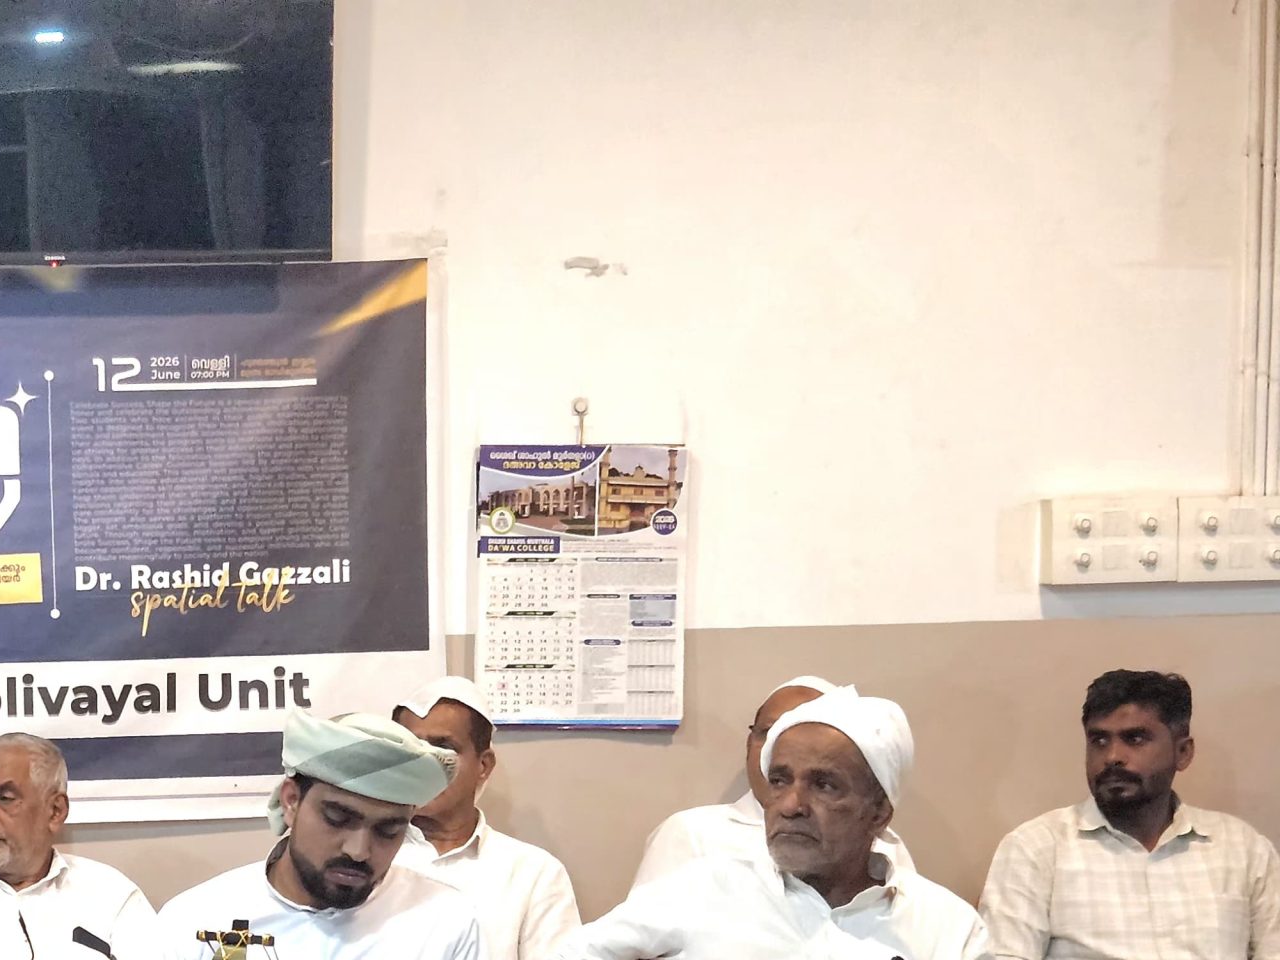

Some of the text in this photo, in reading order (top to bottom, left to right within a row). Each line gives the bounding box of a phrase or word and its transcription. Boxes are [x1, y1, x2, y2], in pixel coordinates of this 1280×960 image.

[150, 356, 180, 367] 2026
[92, 357, 141, 391] 12
[150, 370, 181, 380] June
[191, 370, 230, 379] 07:00 PM
[75, 559, 351, 591] Dr. Rashid Gazzali
[198, 666, 312, 712] Unit
